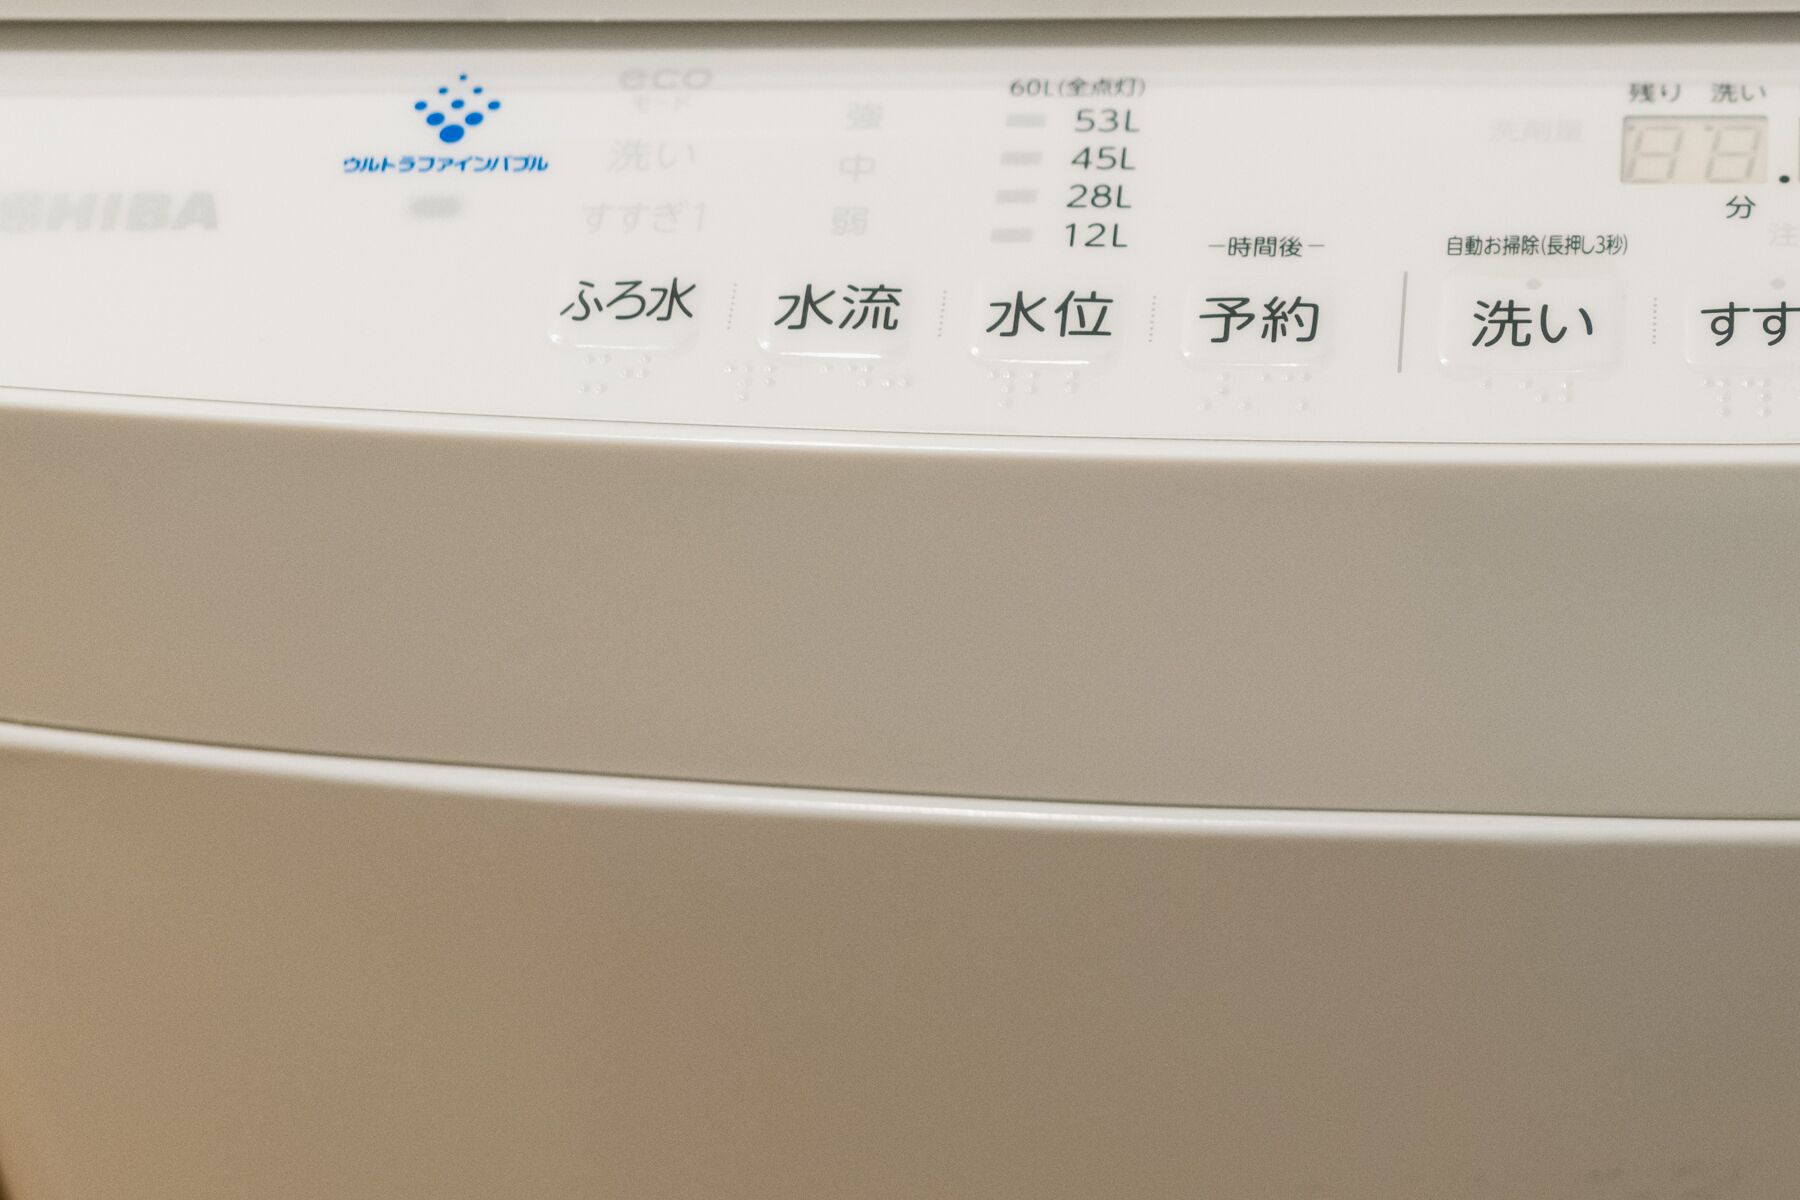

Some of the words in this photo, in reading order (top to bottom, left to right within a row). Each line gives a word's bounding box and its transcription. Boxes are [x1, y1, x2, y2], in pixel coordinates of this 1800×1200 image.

[1711, 82, 1766, 104] 洗い
[1075, 108, 1139, 133] 53L
[343, 155, 549, 173] ウルトラファインバブル
[838, 152, 876, 184] 中
[1071, 146, 1135, 170] 45L
[1066, 184, 1131, 209] 28L
[1725, 195, 1756, 220] 分
[1065, 222, 1128, 248] 12L
[559, 276, 697, 322] ふろ水
[773, 283, 903, 331] 水流
[985, 290, 1114, 338] 水位
[1198, 295, 1320, 344] 予約
[1471, 299, 1593, 348] 洗い
